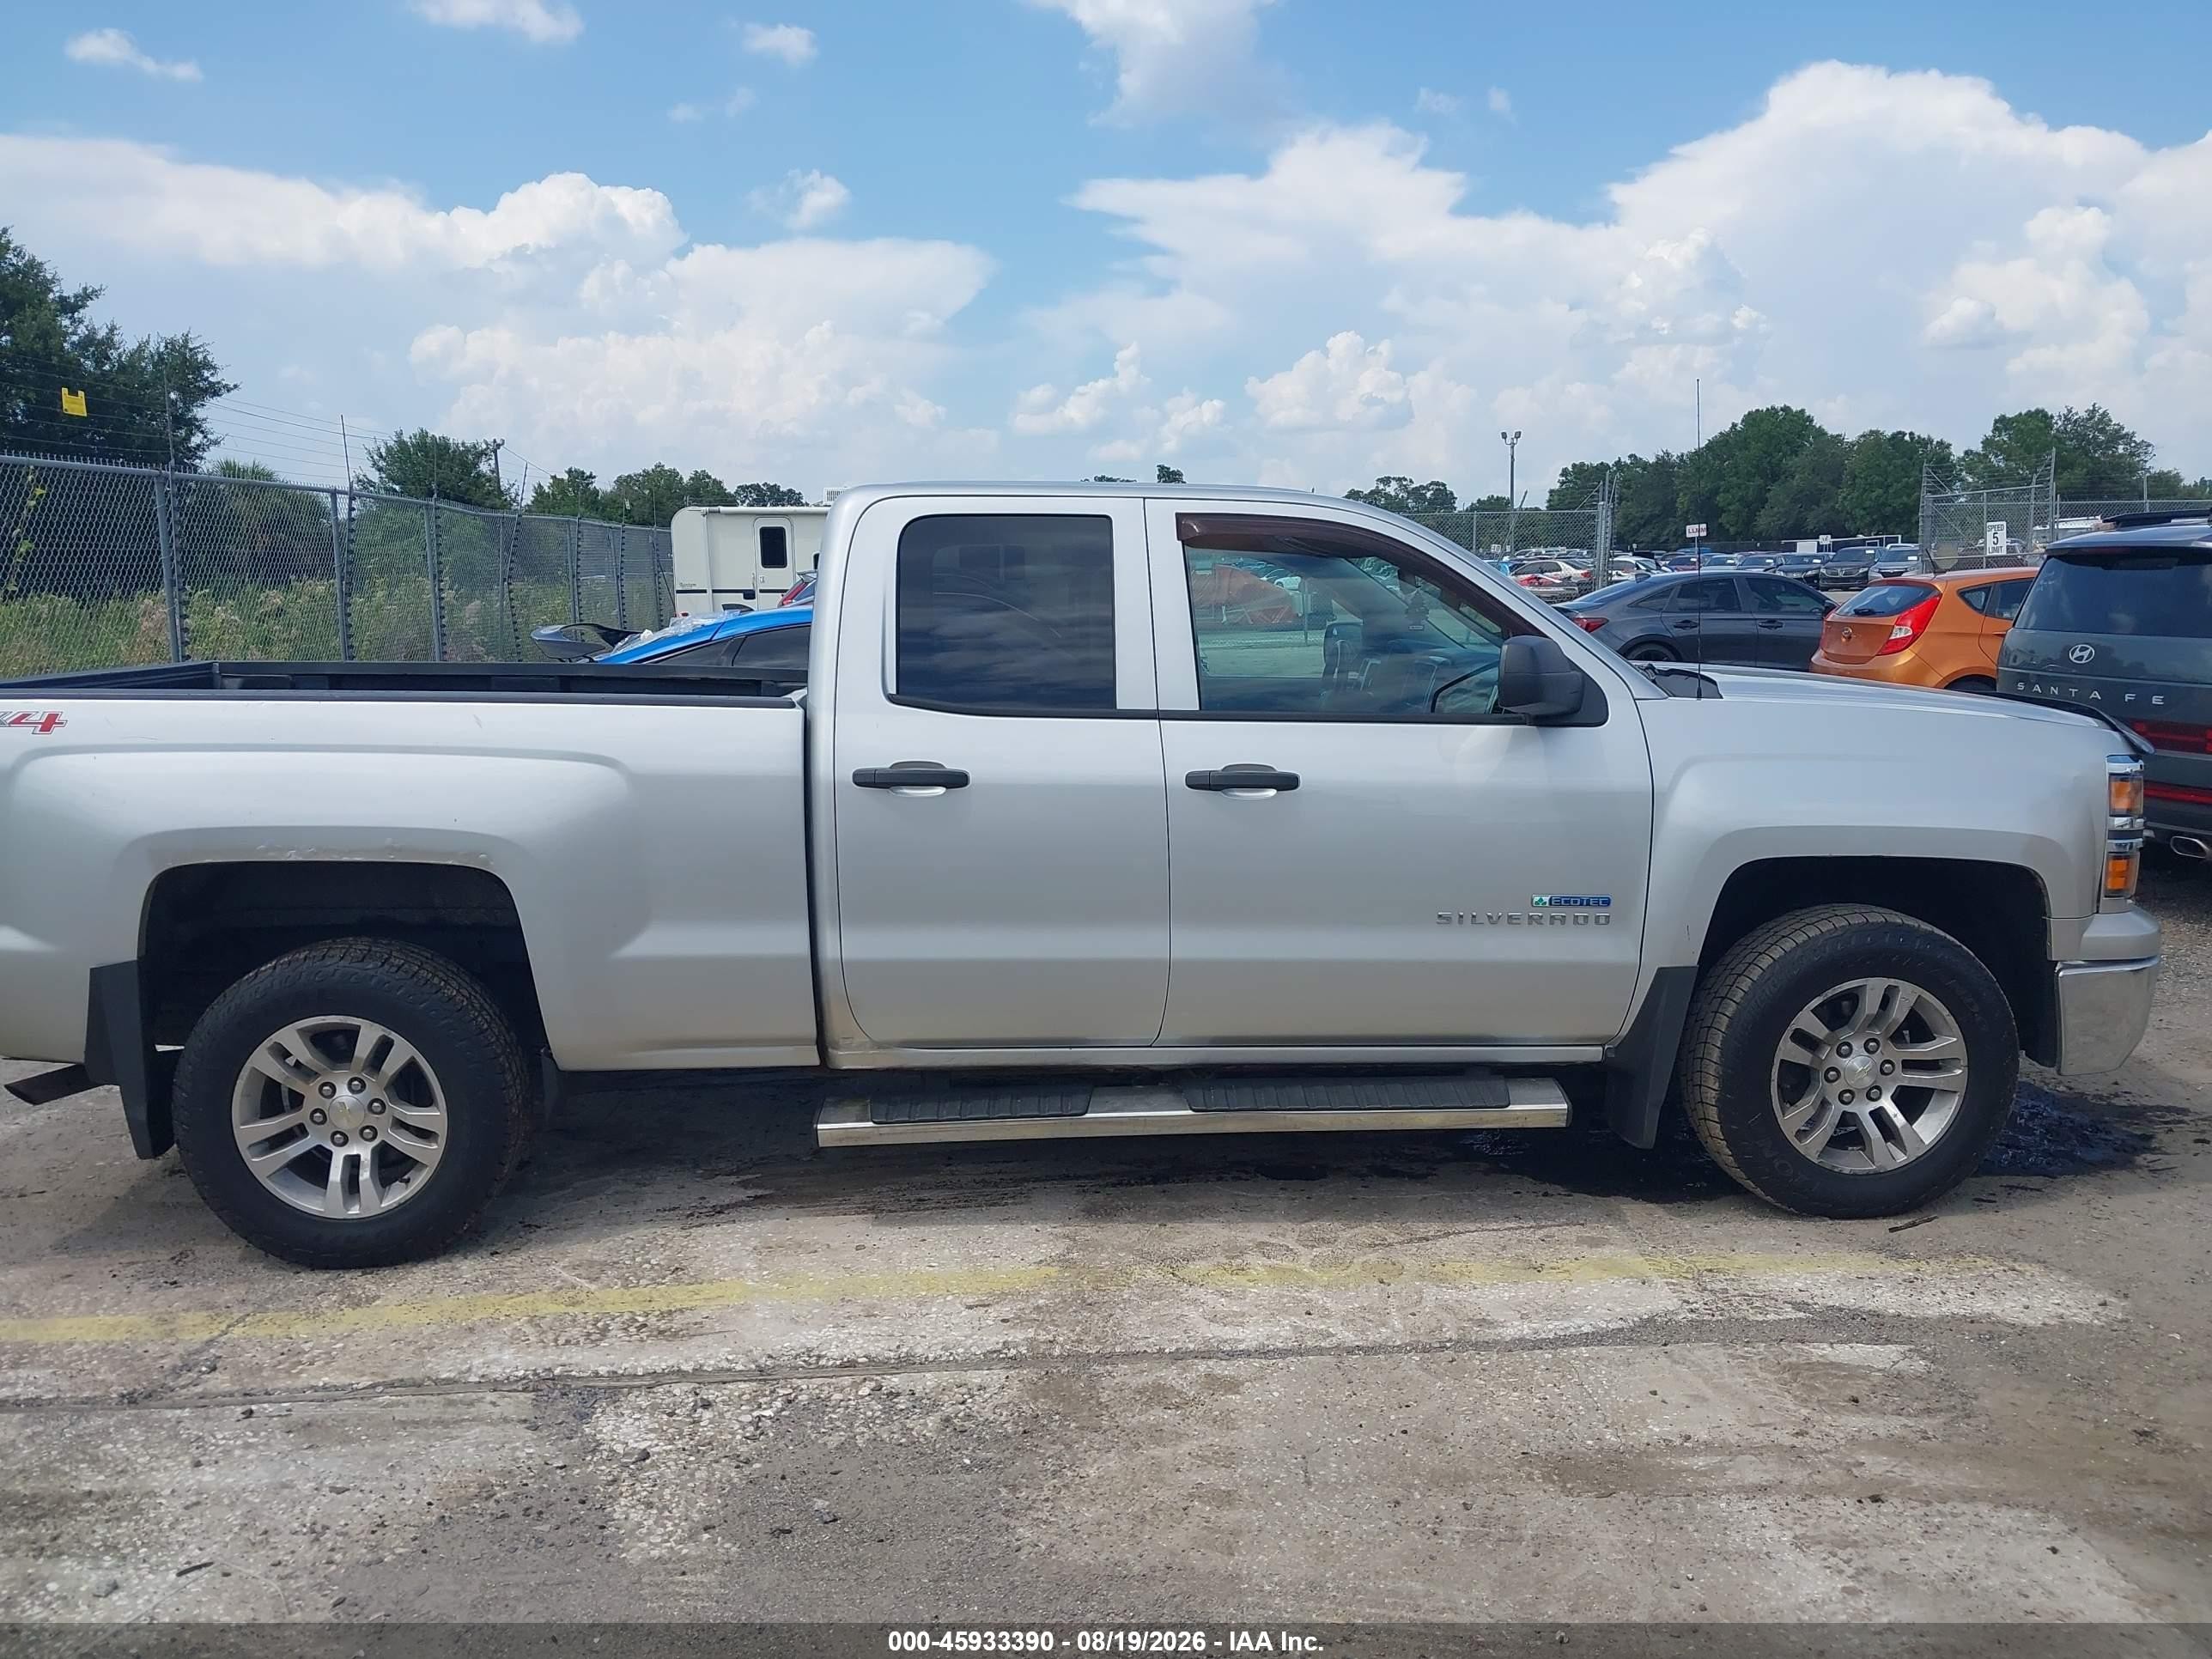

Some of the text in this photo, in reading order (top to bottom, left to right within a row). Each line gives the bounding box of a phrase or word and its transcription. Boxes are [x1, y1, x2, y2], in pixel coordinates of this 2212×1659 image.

[1992, 532, 1999, 545] 5
[2017, 682, 2165, 705] SANTA FE
[1551, 896, 1610, 907] ECOTEC
[1436, 912, 1611, 926] SILVERADO
